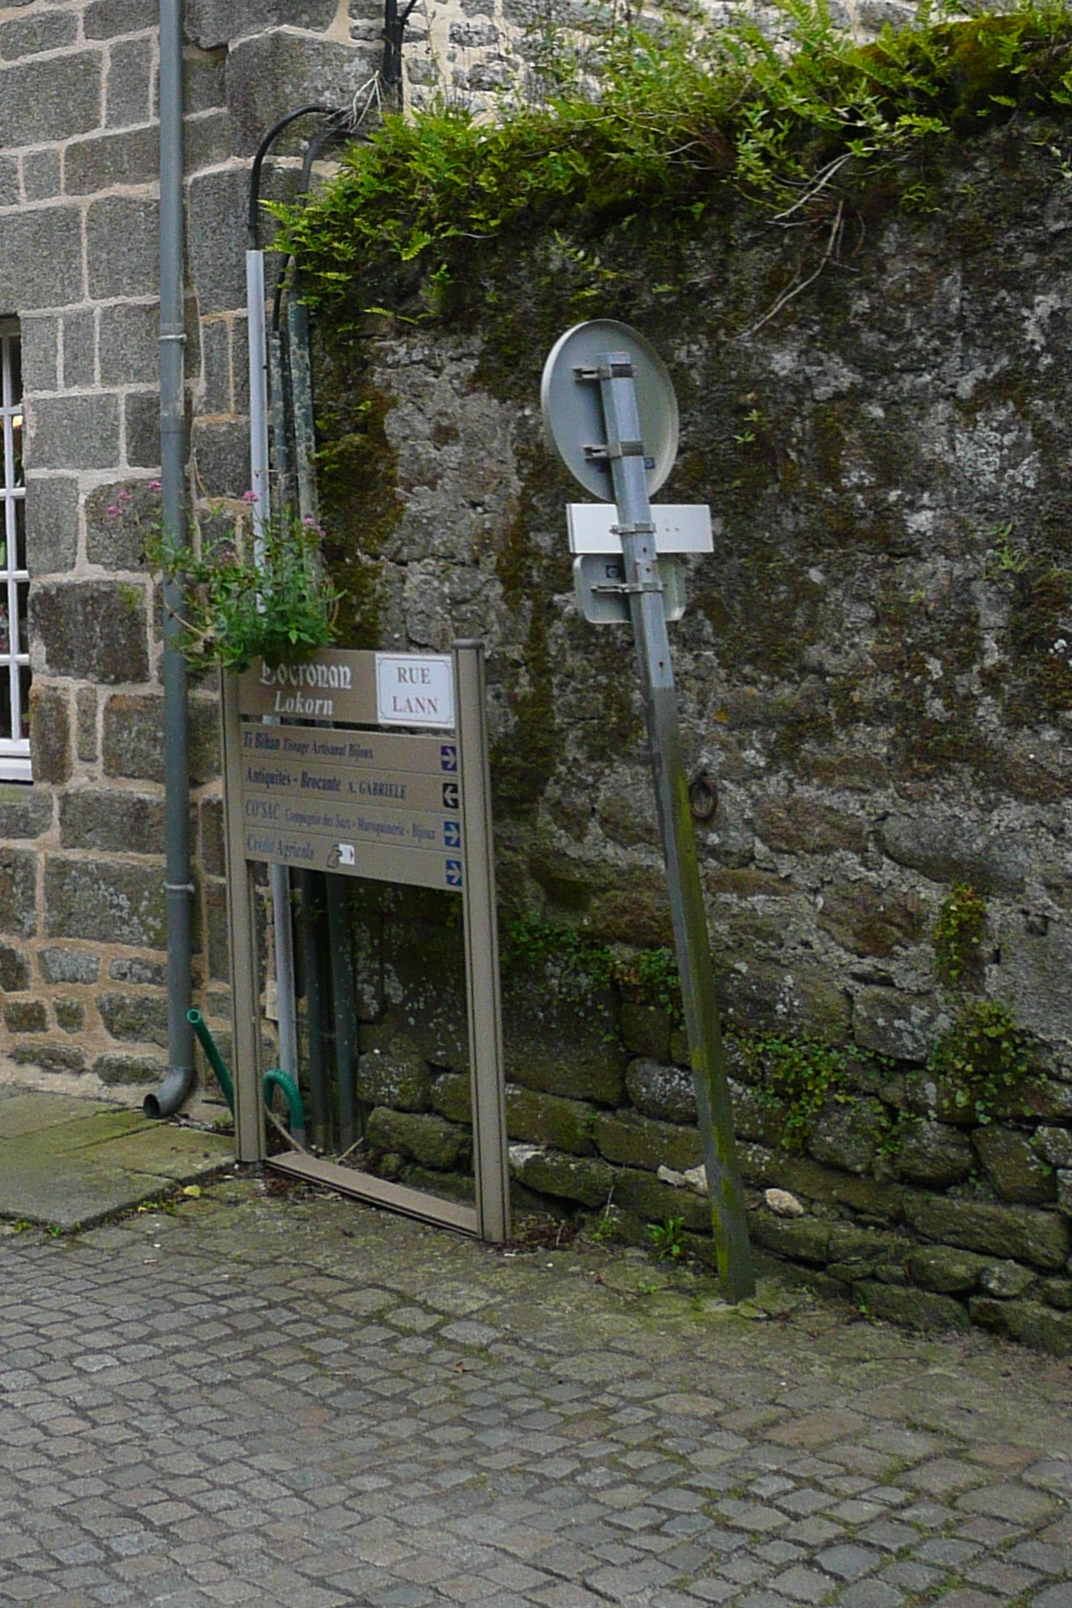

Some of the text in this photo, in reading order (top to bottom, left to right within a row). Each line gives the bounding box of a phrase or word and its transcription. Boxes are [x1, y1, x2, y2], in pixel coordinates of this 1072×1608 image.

[397, 666, 431, 685] RUE
[274, 690, 334, 716] Lokorn
[392, 695, 438, 715] LANN
[300, 770, 342, 792] Brocante
[359, 780, 407, 800] GABRIELE
[277, 839, 315, 862] Agricole
